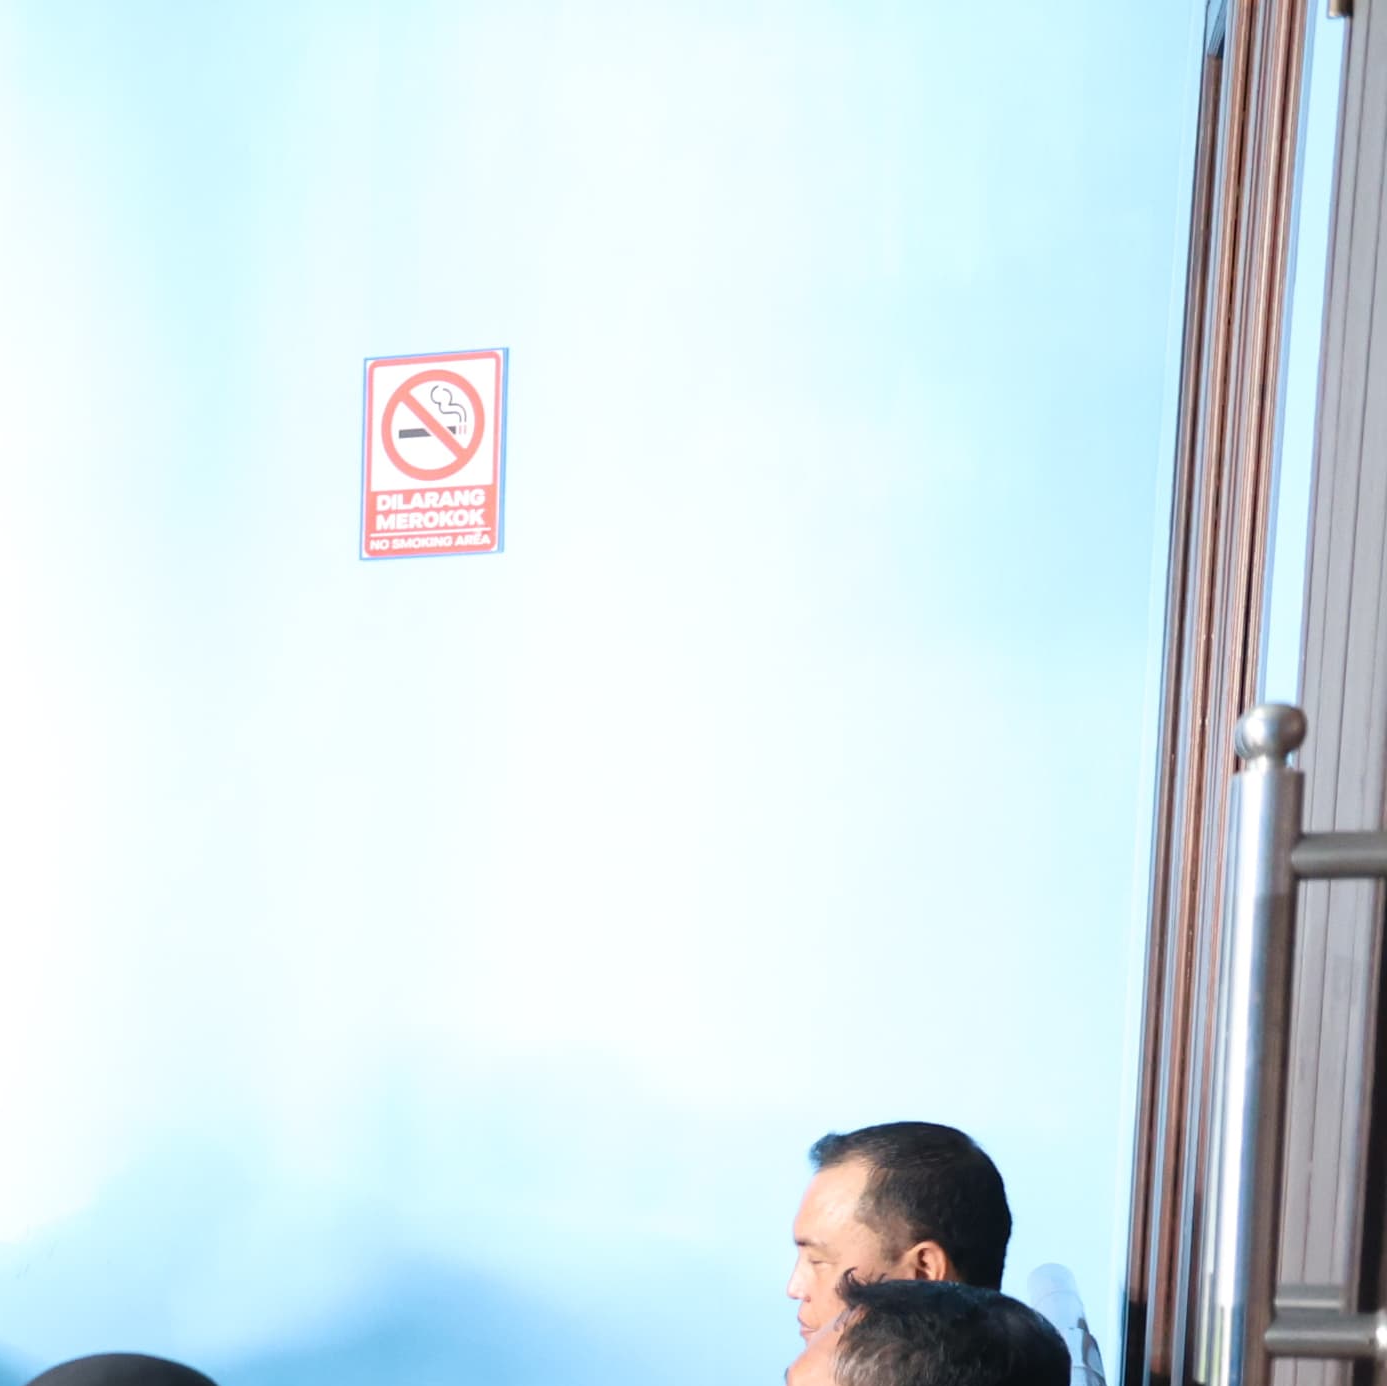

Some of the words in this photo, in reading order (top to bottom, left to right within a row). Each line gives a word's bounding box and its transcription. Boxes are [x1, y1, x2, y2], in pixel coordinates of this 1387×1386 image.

[376, 488, 486, 511] DILARANG
[376, 508, 486, 530] MEROKOK
[370, 538, 389, 550] NO
[392, 535, 453, 549] SMOKING
[454, 533, 491, 546] AREA
